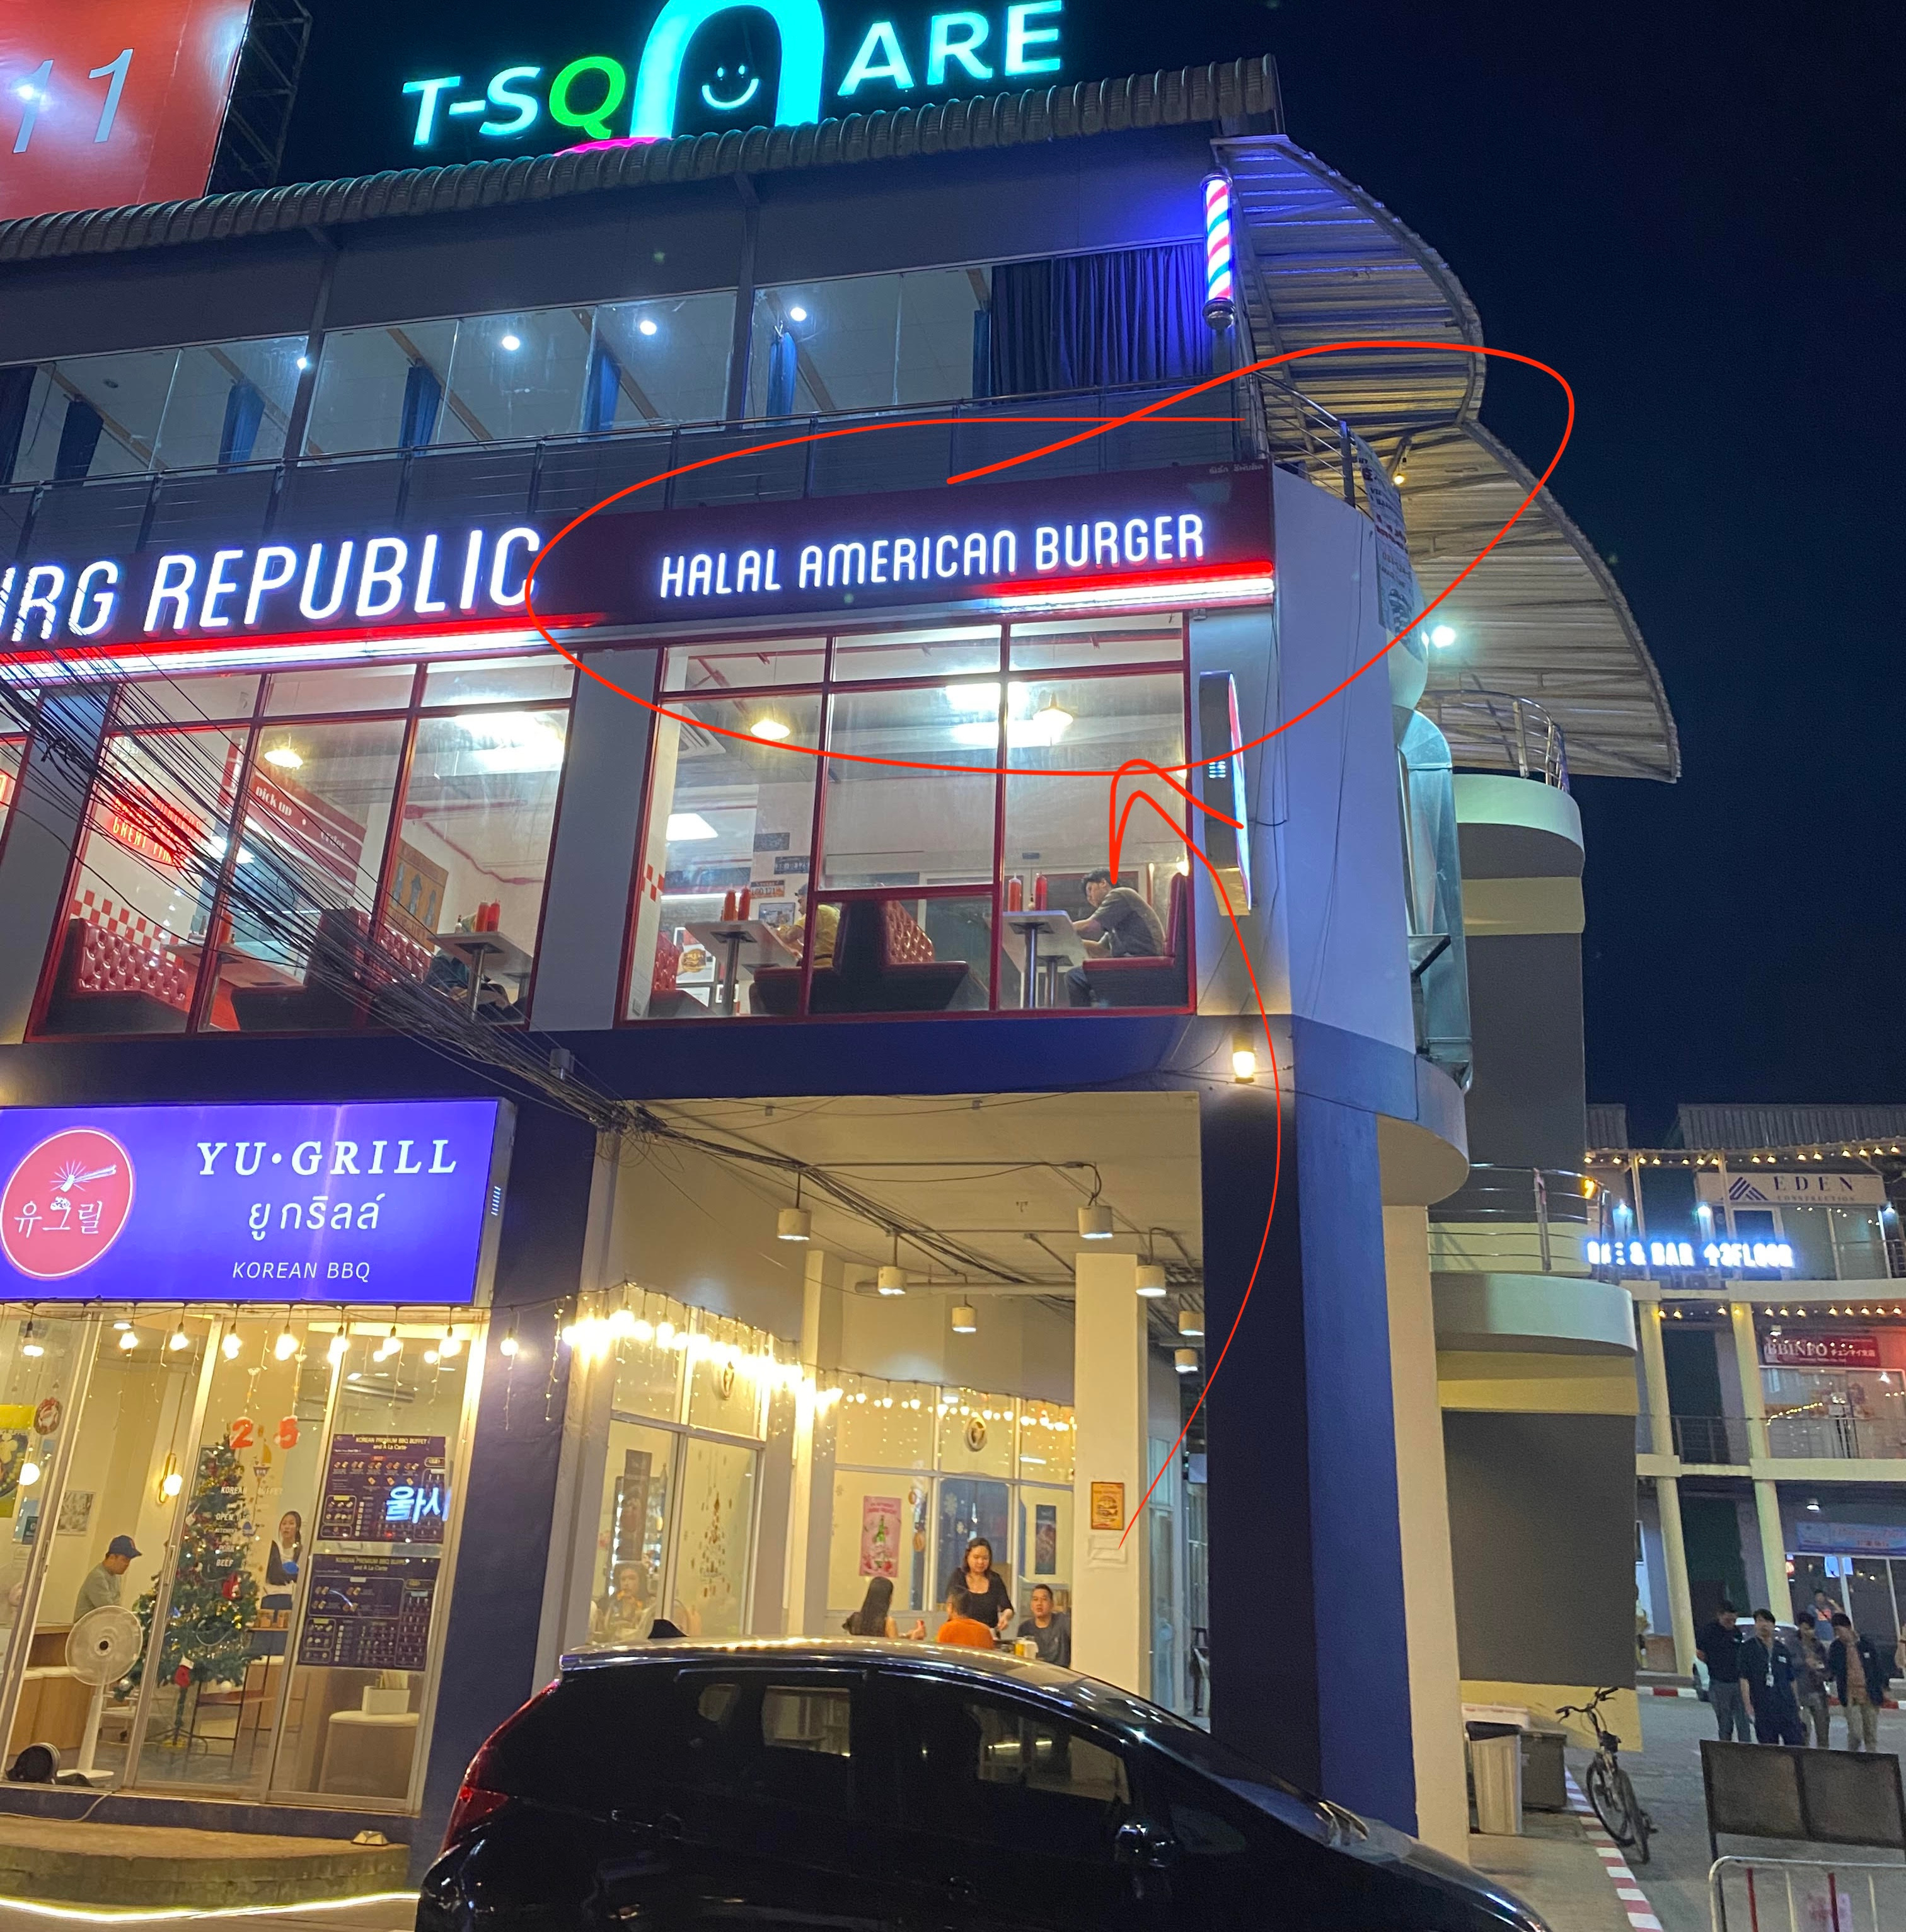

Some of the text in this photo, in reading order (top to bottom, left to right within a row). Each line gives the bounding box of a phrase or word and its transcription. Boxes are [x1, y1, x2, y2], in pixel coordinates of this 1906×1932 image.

[660, 514, 1204, 598] HALAL AMERICAN BURGER
[143, 526, 540, 633] REPUBLIC
[255, 786, 292, 816] pick up
[1773, 1176, 1854, 1191] EDEN
[232, 1261, 371, 1283] KOREAN BBQ
[216, 1559, 234, 1567] BEEF
